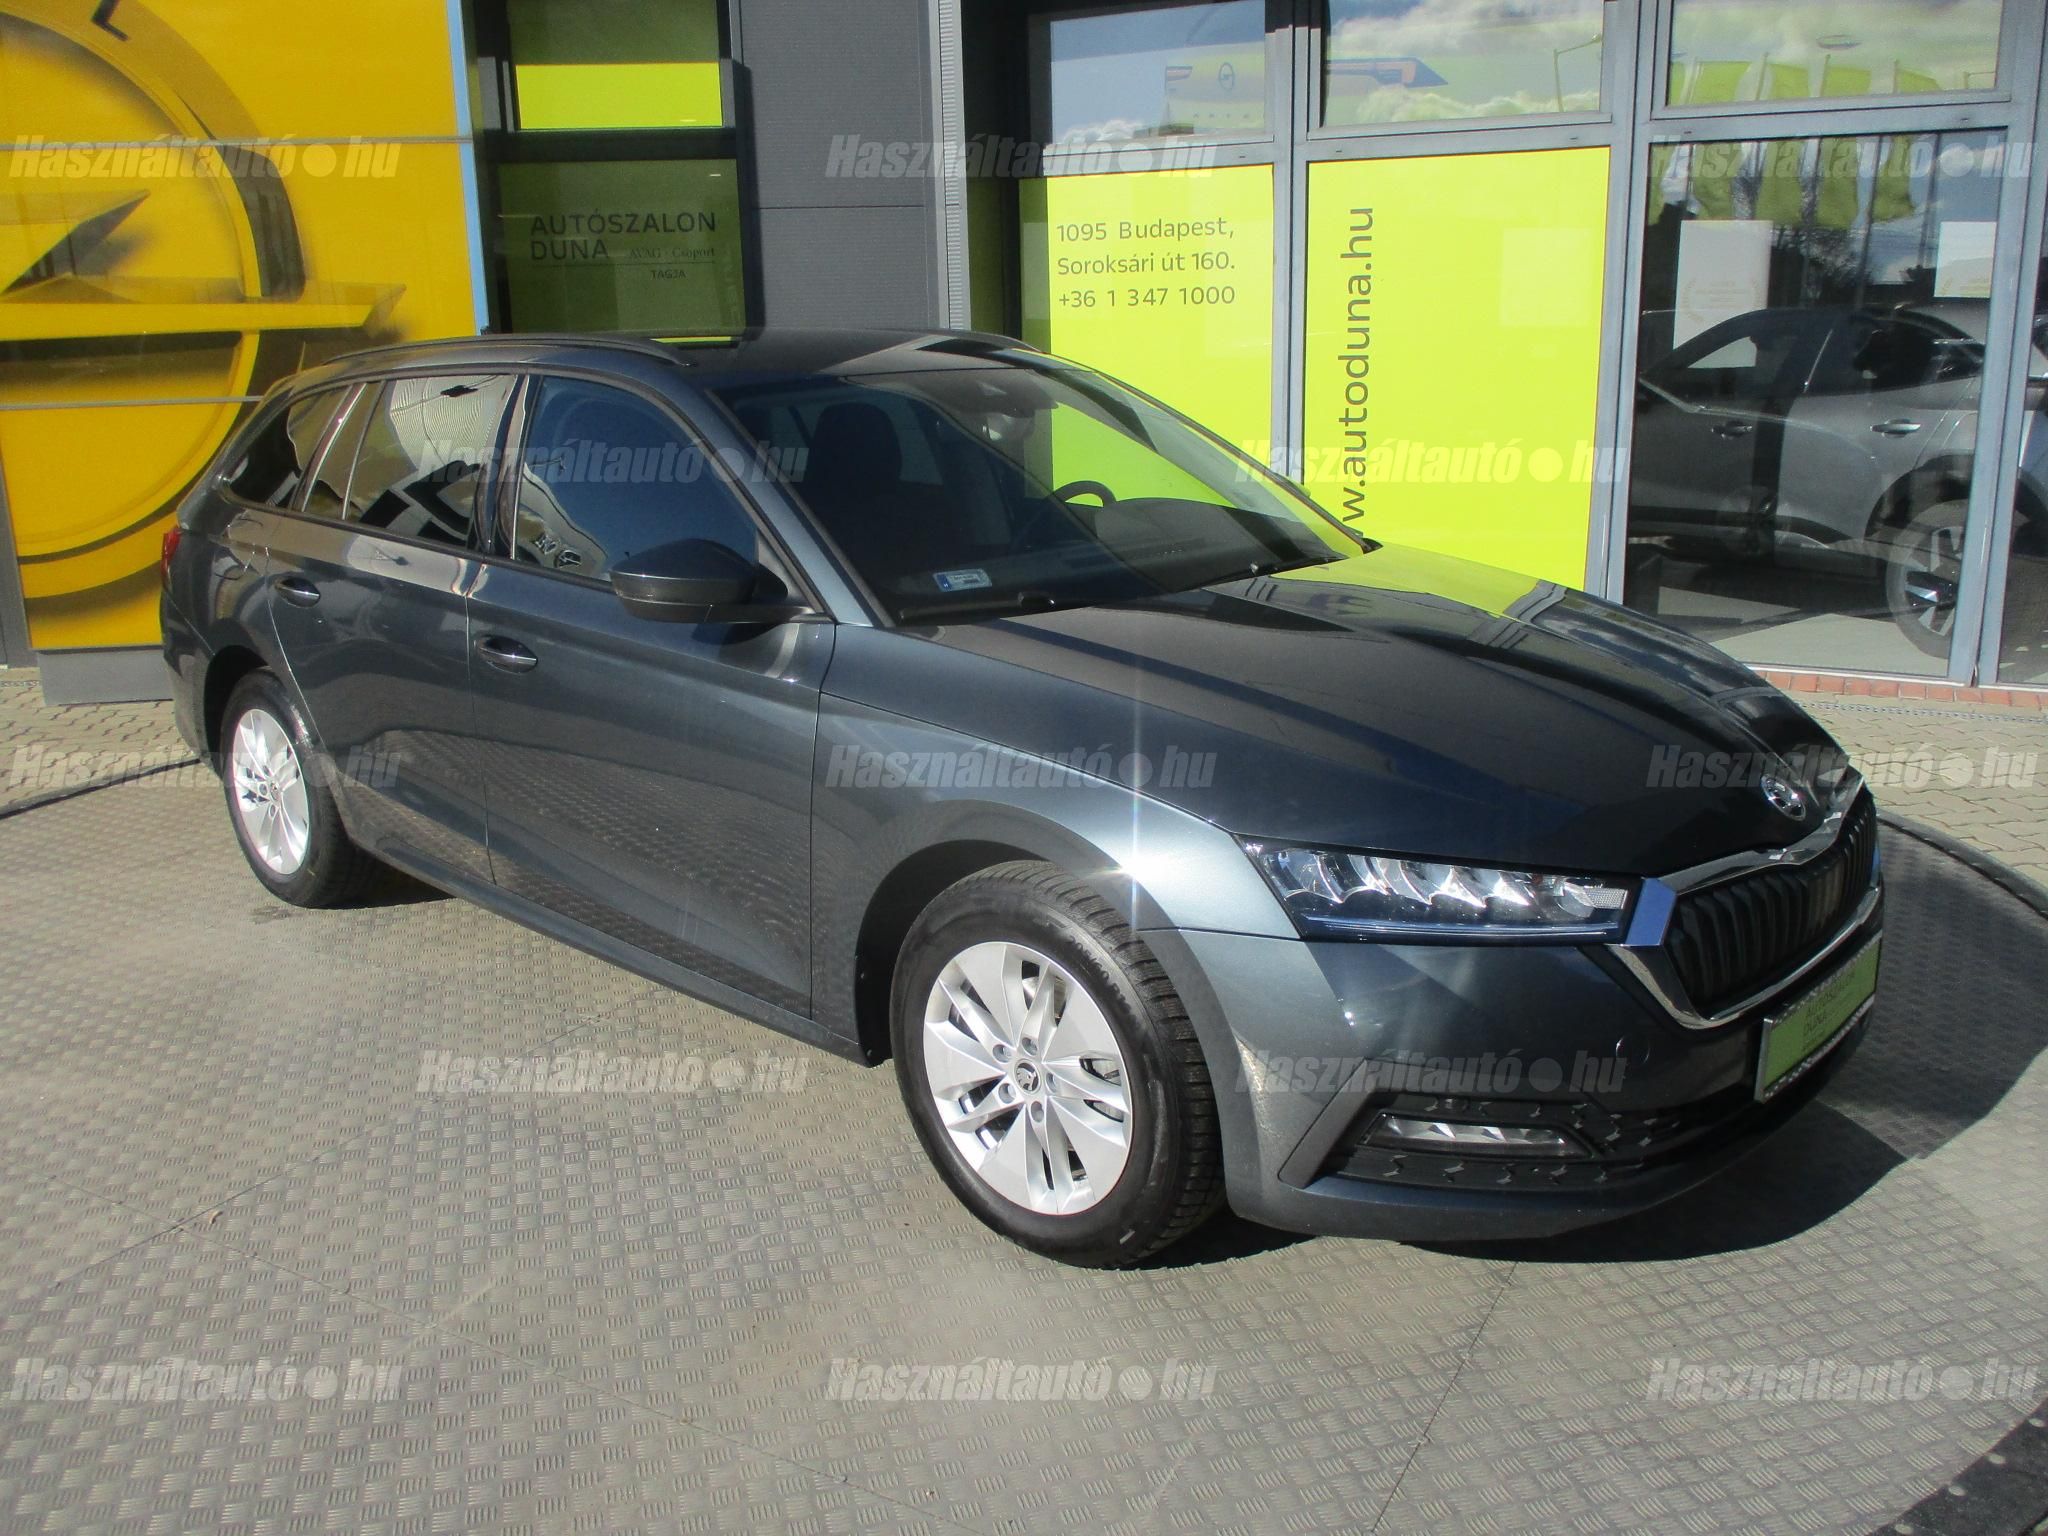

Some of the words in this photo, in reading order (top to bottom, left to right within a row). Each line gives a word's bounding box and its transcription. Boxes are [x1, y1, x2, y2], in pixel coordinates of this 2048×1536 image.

[531, 208, 716, 236] AUTÓSZALON
[1056, 222, 1107, 242] 1095
[1119, 217, 1235, 241] Budapest,
[531, 239, 609, 261] DUNA
[1057, 252, 1154, 275] Soroksári
[1161, 252, 1186, 271] út
[1191, 251, 1236, 271] 160.
[1058, 289, 1096, 308] +36
[1107, 289, 1116, 307] 1
[1127, 287, 1169, 307] 347
[1179, 286, 1236, 305] 1000
[1337, 207, 1374, 537] w.autoduna.hu
